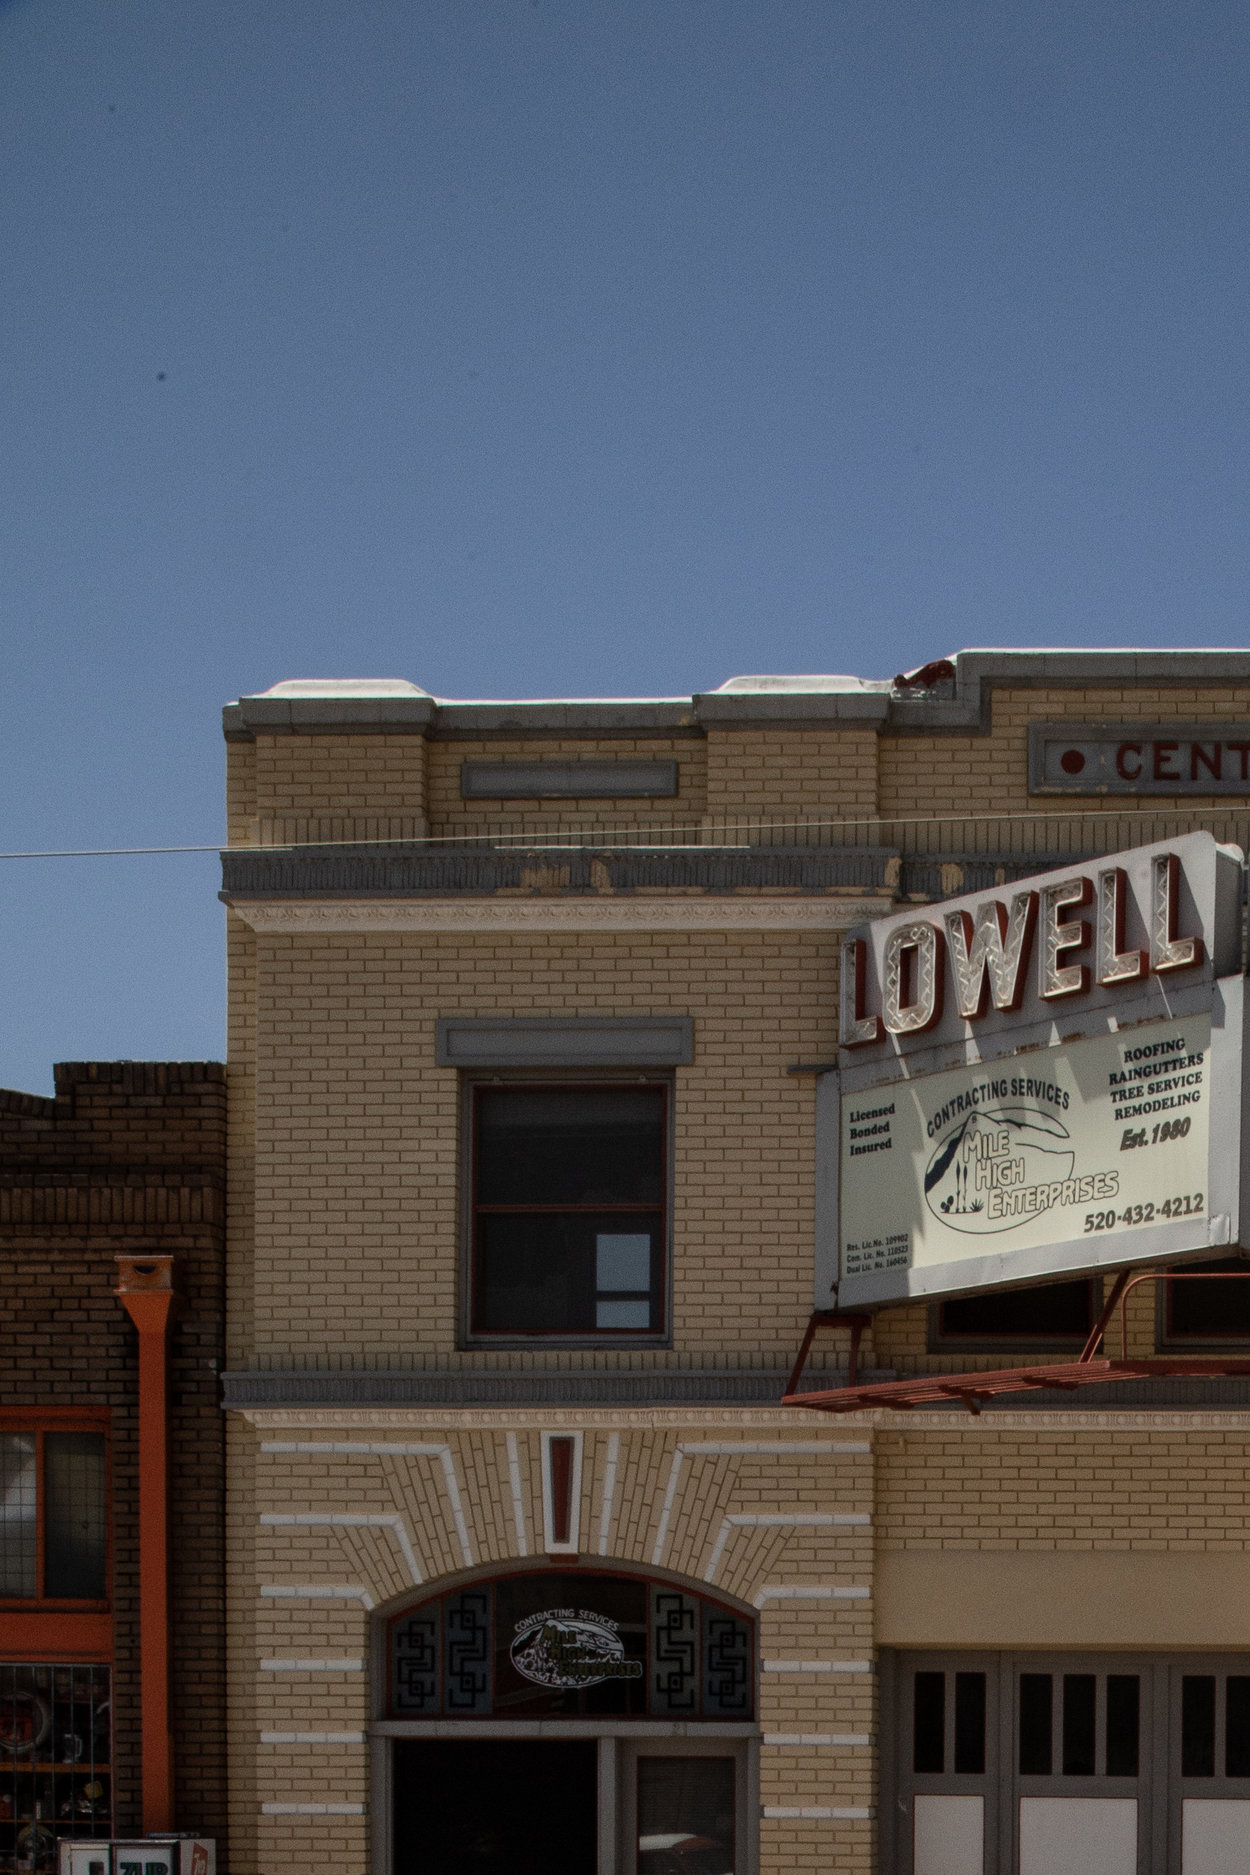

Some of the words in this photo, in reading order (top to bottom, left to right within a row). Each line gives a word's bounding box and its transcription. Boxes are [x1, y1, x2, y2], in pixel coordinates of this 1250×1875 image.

[840, 852, 1205, 1049] LOWELL
[1123, 1038, 1186, 1063] ROOFING
[1108, 1053, 1204, 1086] RAINGUTTERS
[1110, 1083, 1145, 1104] TREE
[1146, 1071, 1203, 1097] SERVICE
[849, 1103, 896, 1123] Licensed
[926, 1080, 1008, 1139] CONTRACTING
[1010, 1078, 1070, 1111] SERVICES
[1114, 1091, 1201, 1121] REMODELING
[849, 1121, 890, 1140] Bonded
[962, 1130, 1011, 1163] MILE
[1120, 1128, 1149, 1152] Est.
[1152, 1117, 1191, 1144] 1980
[849, 1138, 892, 1157] Insured
[975, 1158, 1025, 1191] HIGH
[987, 1171, 1119, 1219] ENTERPRISES
[514, 1608, 576, 1633] CONTRACTING
[578, 1608, 620, 1632] SERVICES
